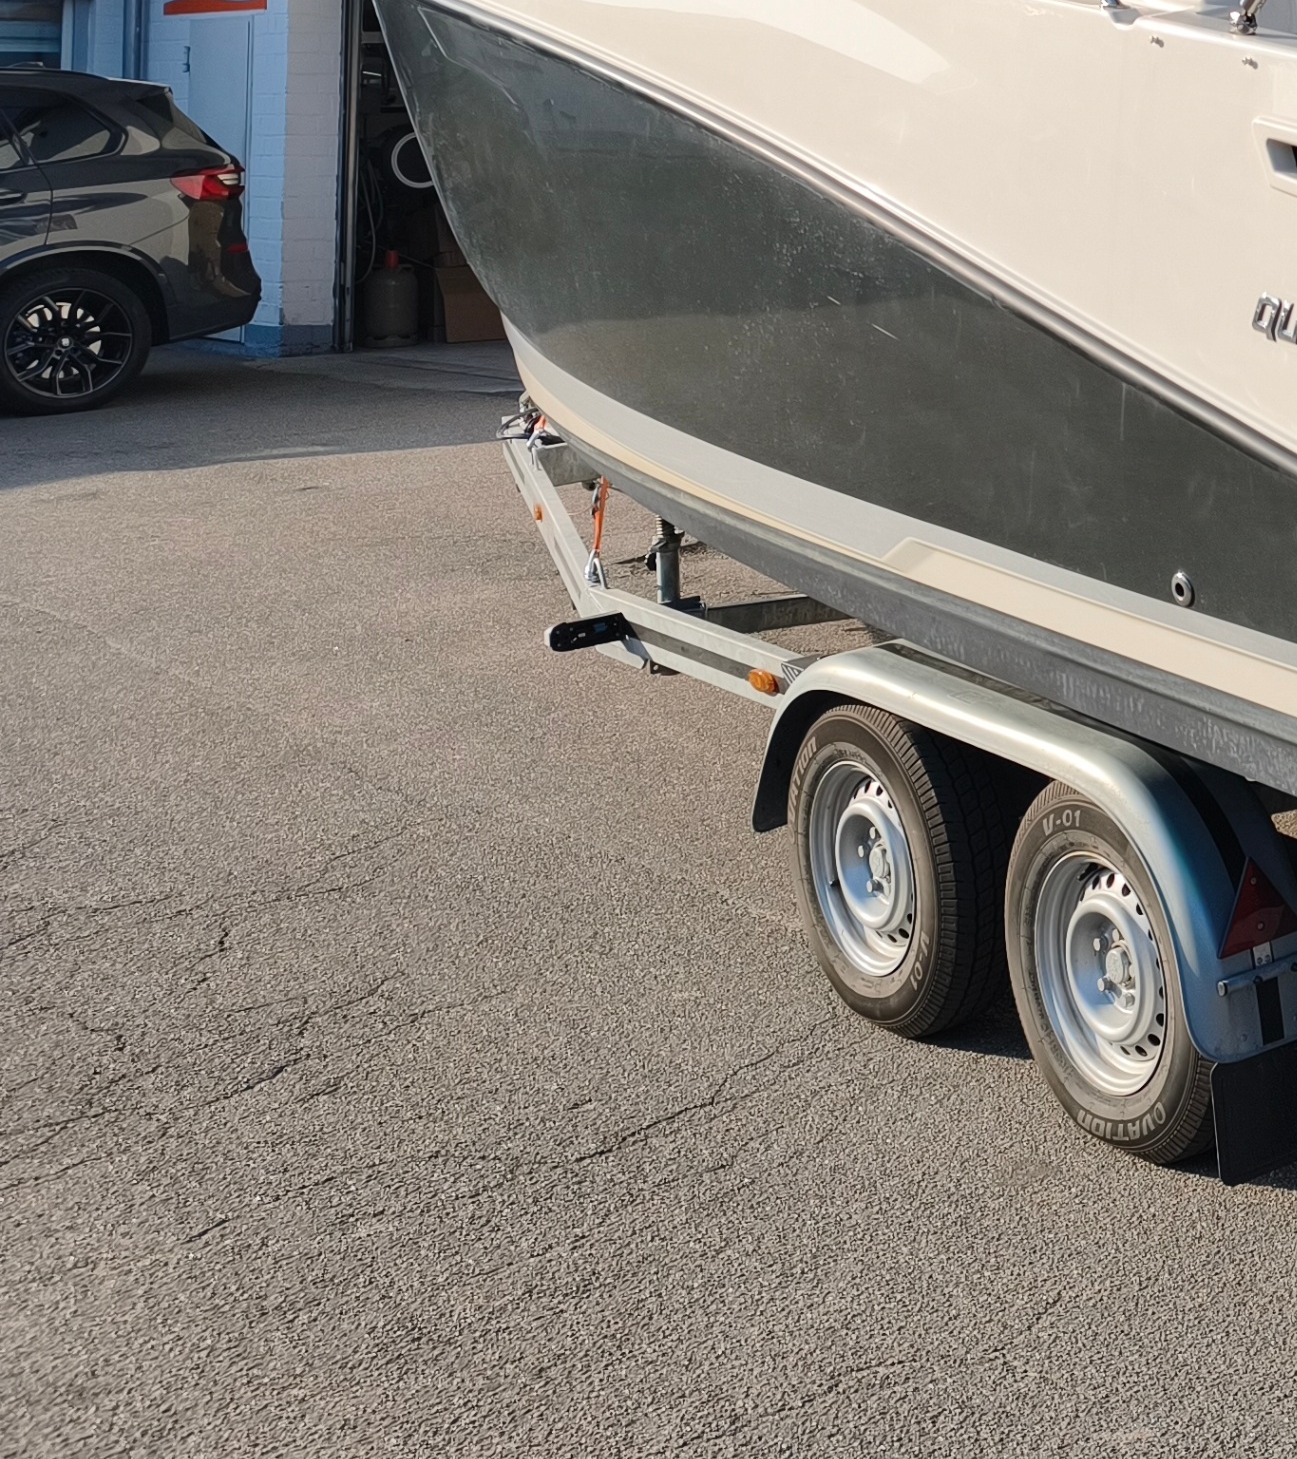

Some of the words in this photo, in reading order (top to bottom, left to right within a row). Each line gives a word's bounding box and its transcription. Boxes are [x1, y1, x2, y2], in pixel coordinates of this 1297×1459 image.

[1042, 809, 1081, 837] V-01
[910, 930, 930, 991] V-01
[1076, 1101, 1167, 1141] OVATION
